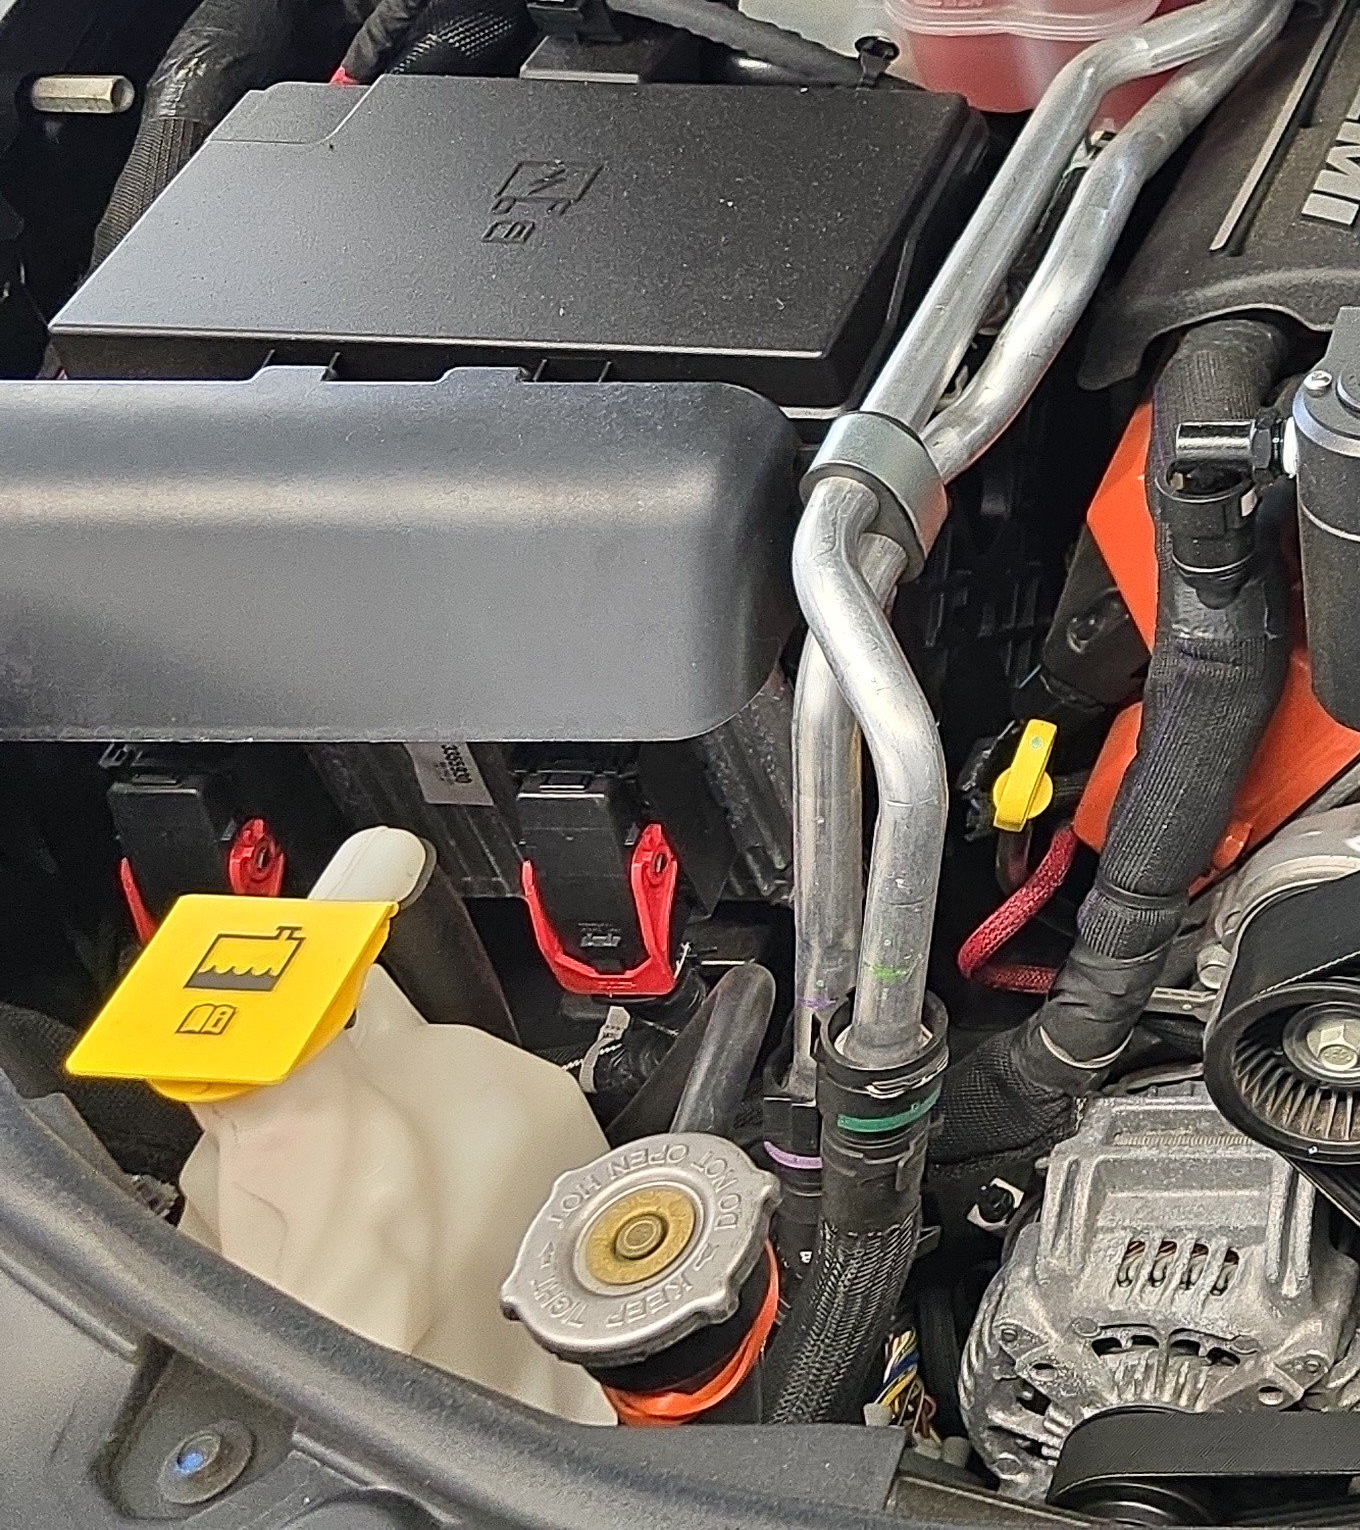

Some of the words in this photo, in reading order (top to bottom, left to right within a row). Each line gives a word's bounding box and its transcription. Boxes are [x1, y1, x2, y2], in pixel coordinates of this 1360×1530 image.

[608, 1143, 691, 1182] OPEN
[691, 1150, 738, 1193] NOT
[550, 1177, 602, 1230] HOT
[606, 1272, 694, 1329] KEEP
